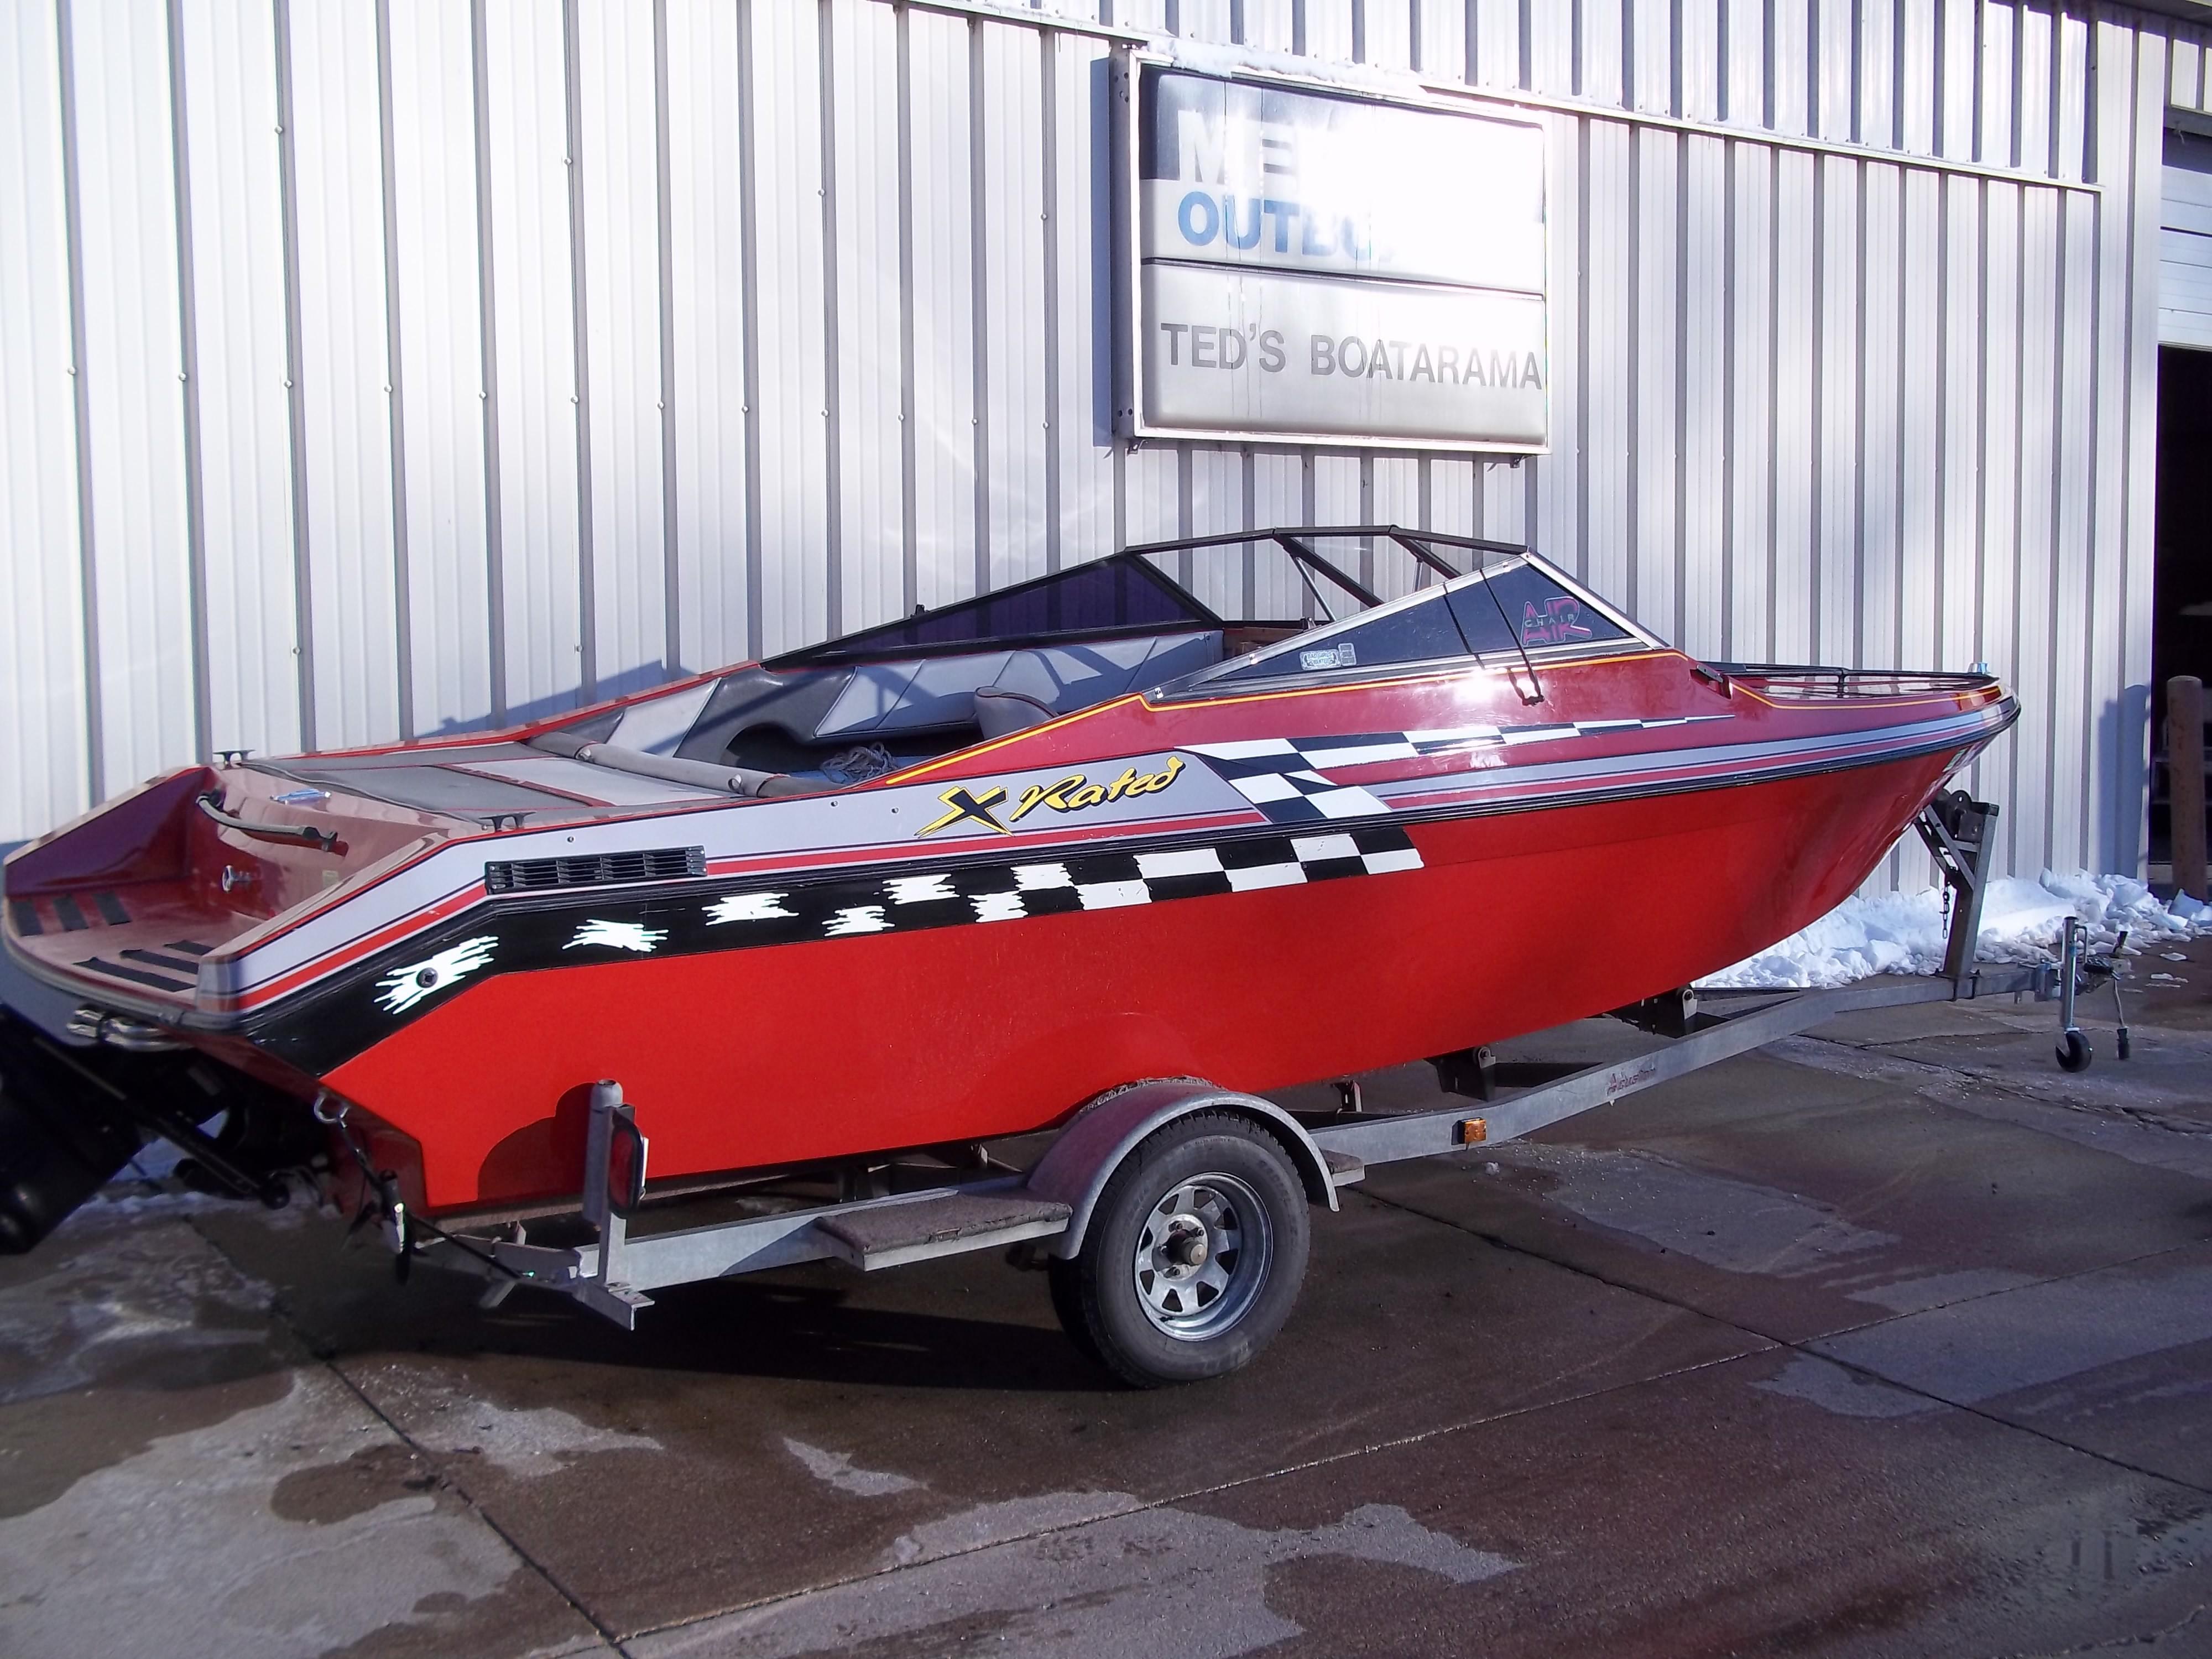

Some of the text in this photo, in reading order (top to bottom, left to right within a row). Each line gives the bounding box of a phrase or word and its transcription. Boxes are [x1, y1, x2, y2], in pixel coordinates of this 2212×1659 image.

[1178, 110, 1297, 194] ME
[1160, 323, 1543, 389] TED'S BOATARAMA
[1524, 614, 1575, 627] CHAIR
[914, 755, 1186, 838] X Rated
